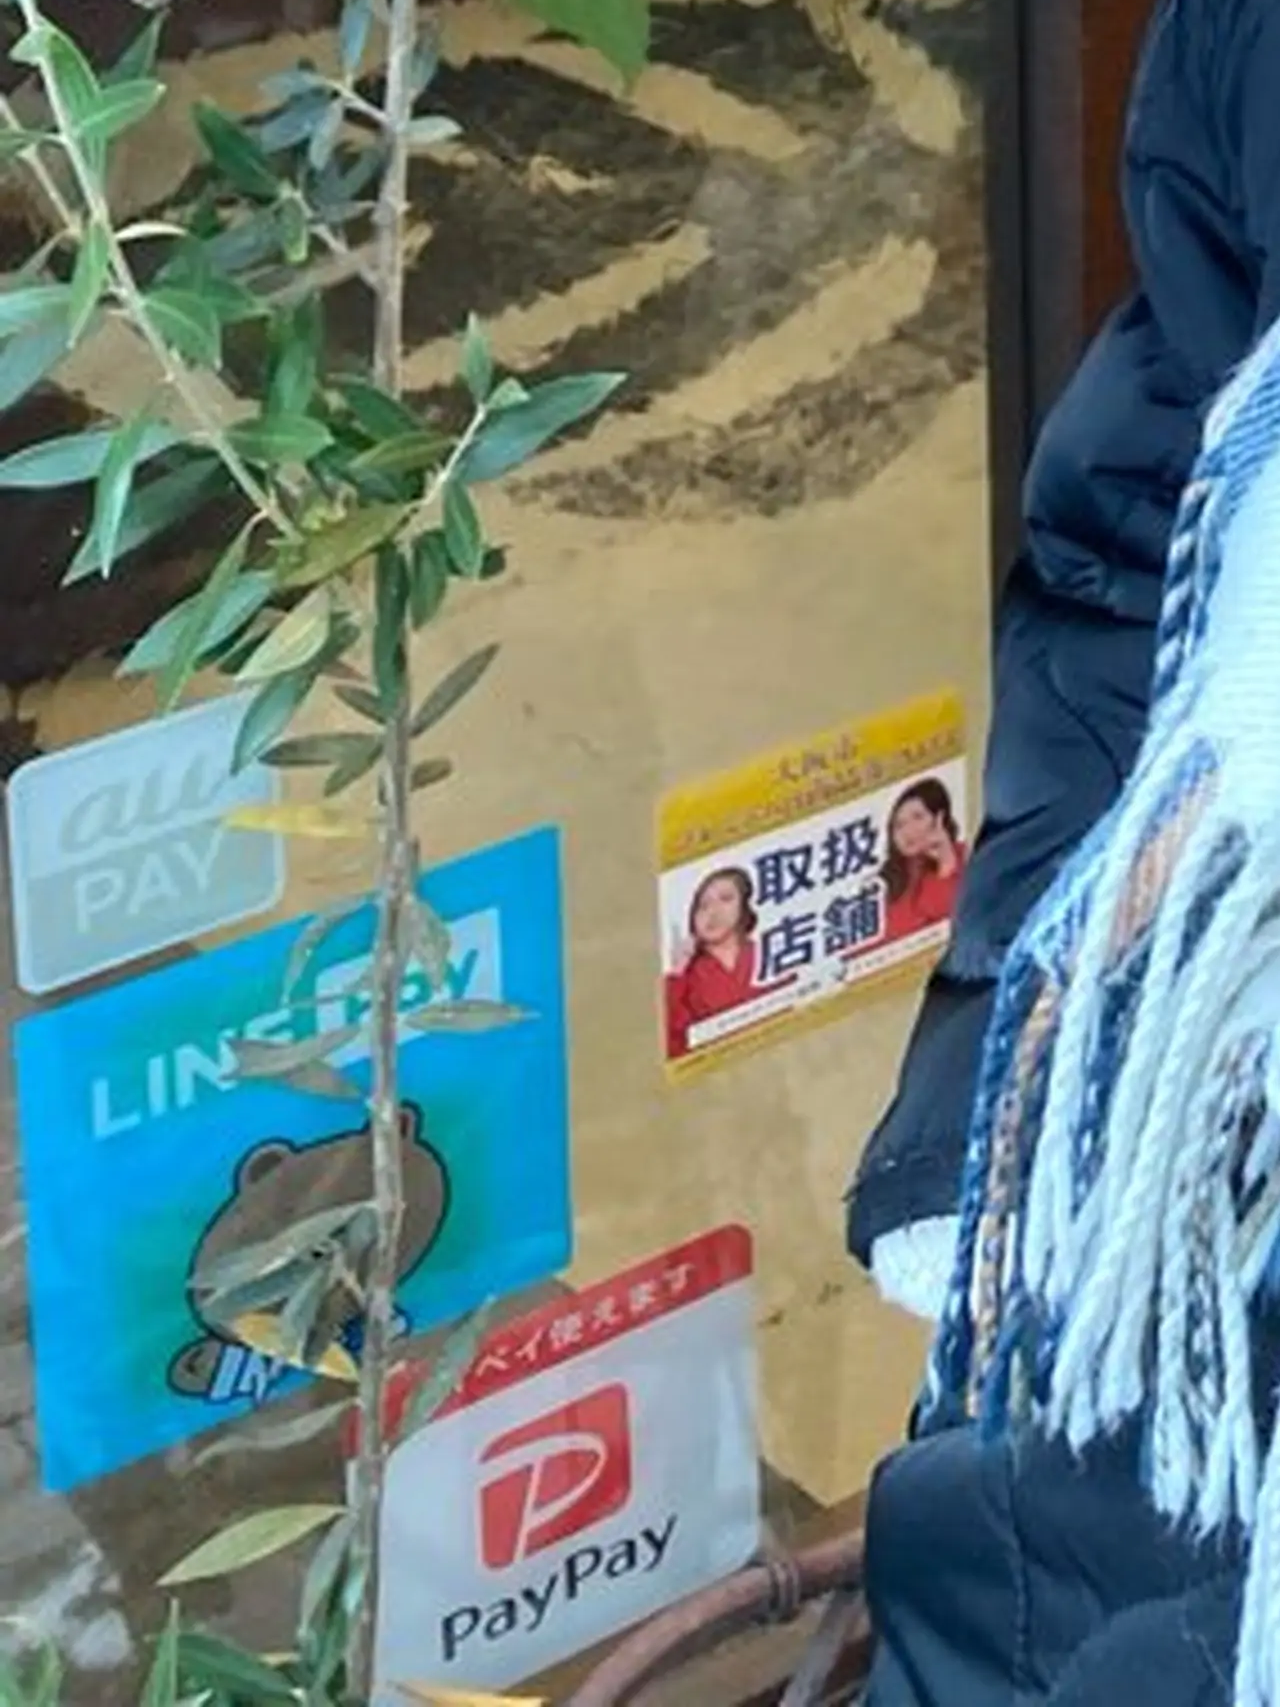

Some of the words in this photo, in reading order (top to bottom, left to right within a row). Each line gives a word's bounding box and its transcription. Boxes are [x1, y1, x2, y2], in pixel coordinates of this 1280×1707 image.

[74, 825, 224, 933] PAY
[754, 816, 879, 906] 取扱
[757, 882, 880, 981] 店舗
[441, 1513, 678, 1662] PayPay
